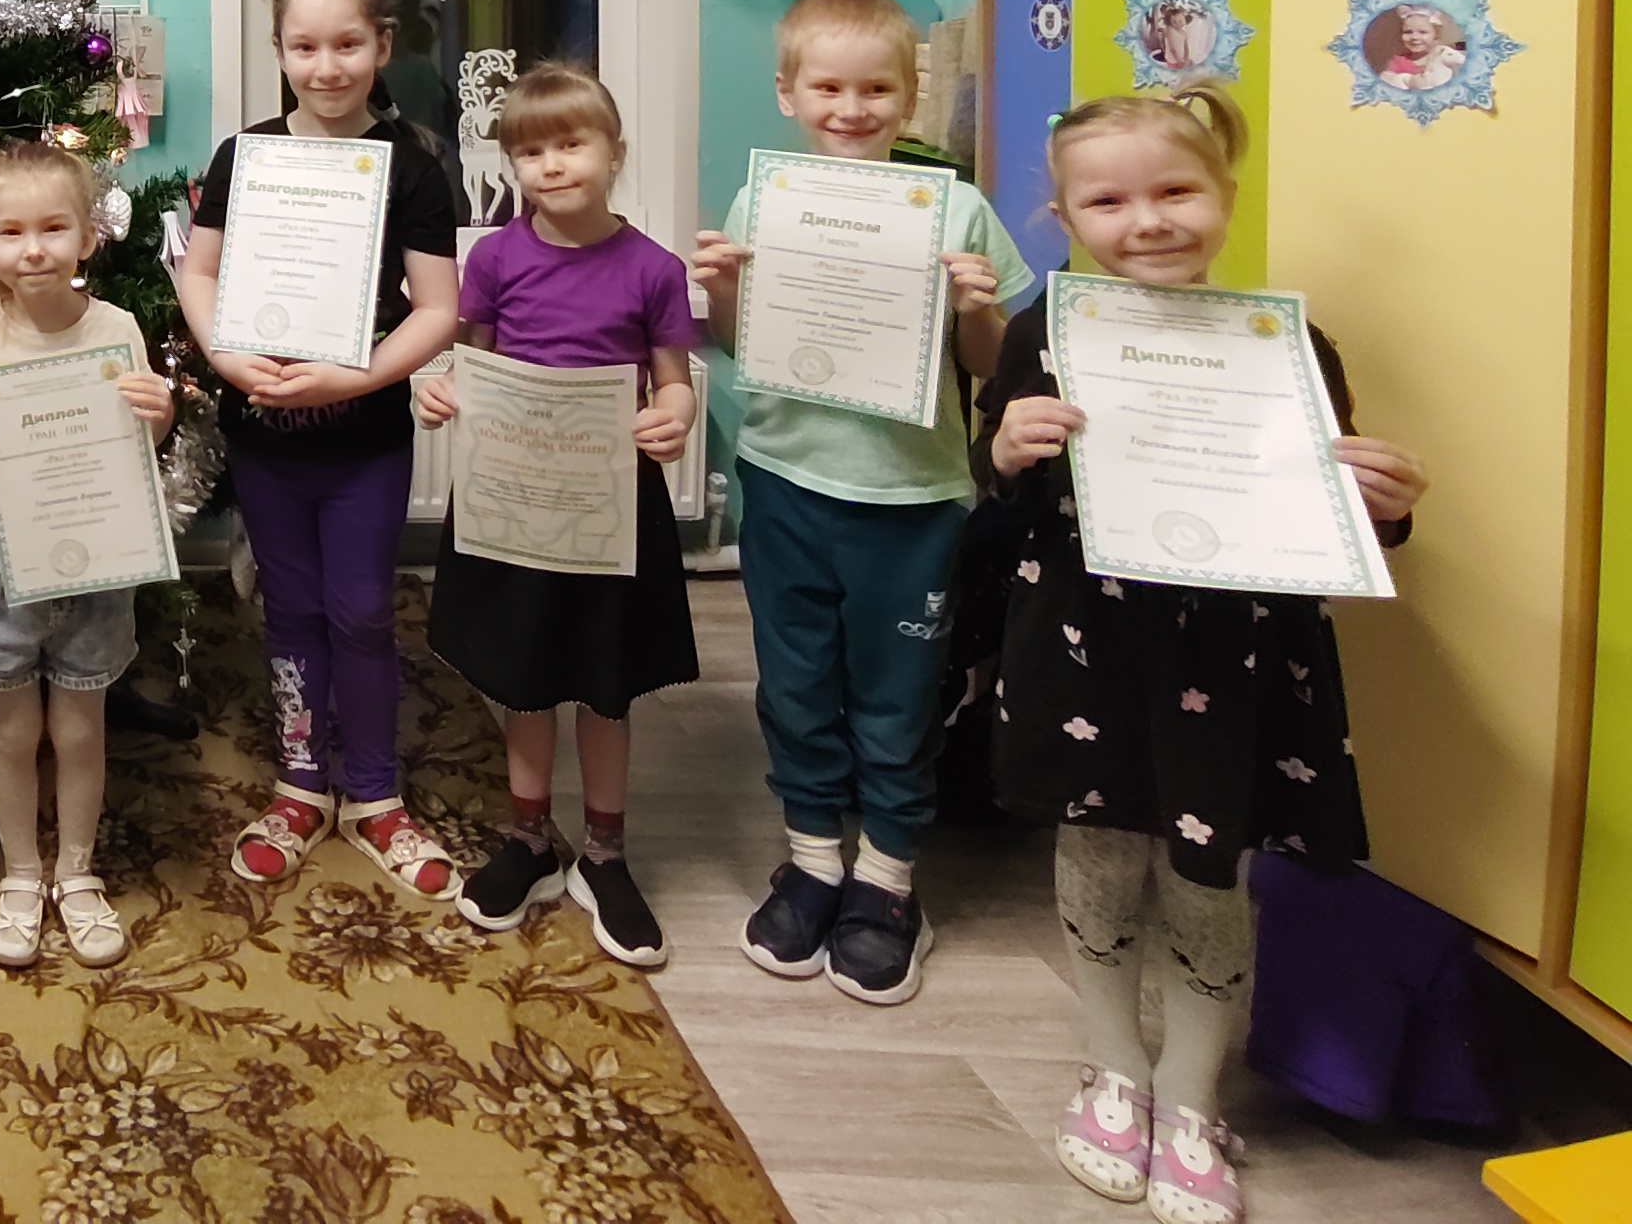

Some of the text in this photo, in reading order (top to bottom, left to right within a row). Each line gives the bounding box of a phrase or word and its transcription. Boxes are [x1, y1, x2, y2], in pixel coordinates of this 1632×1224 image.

[246, 180, 366, 202] Благодарность
[800, 211, 881, 234] Диплом
[1120, 344, 1226, 371] Диплом
[21, 405, 90, 429] Диплом
